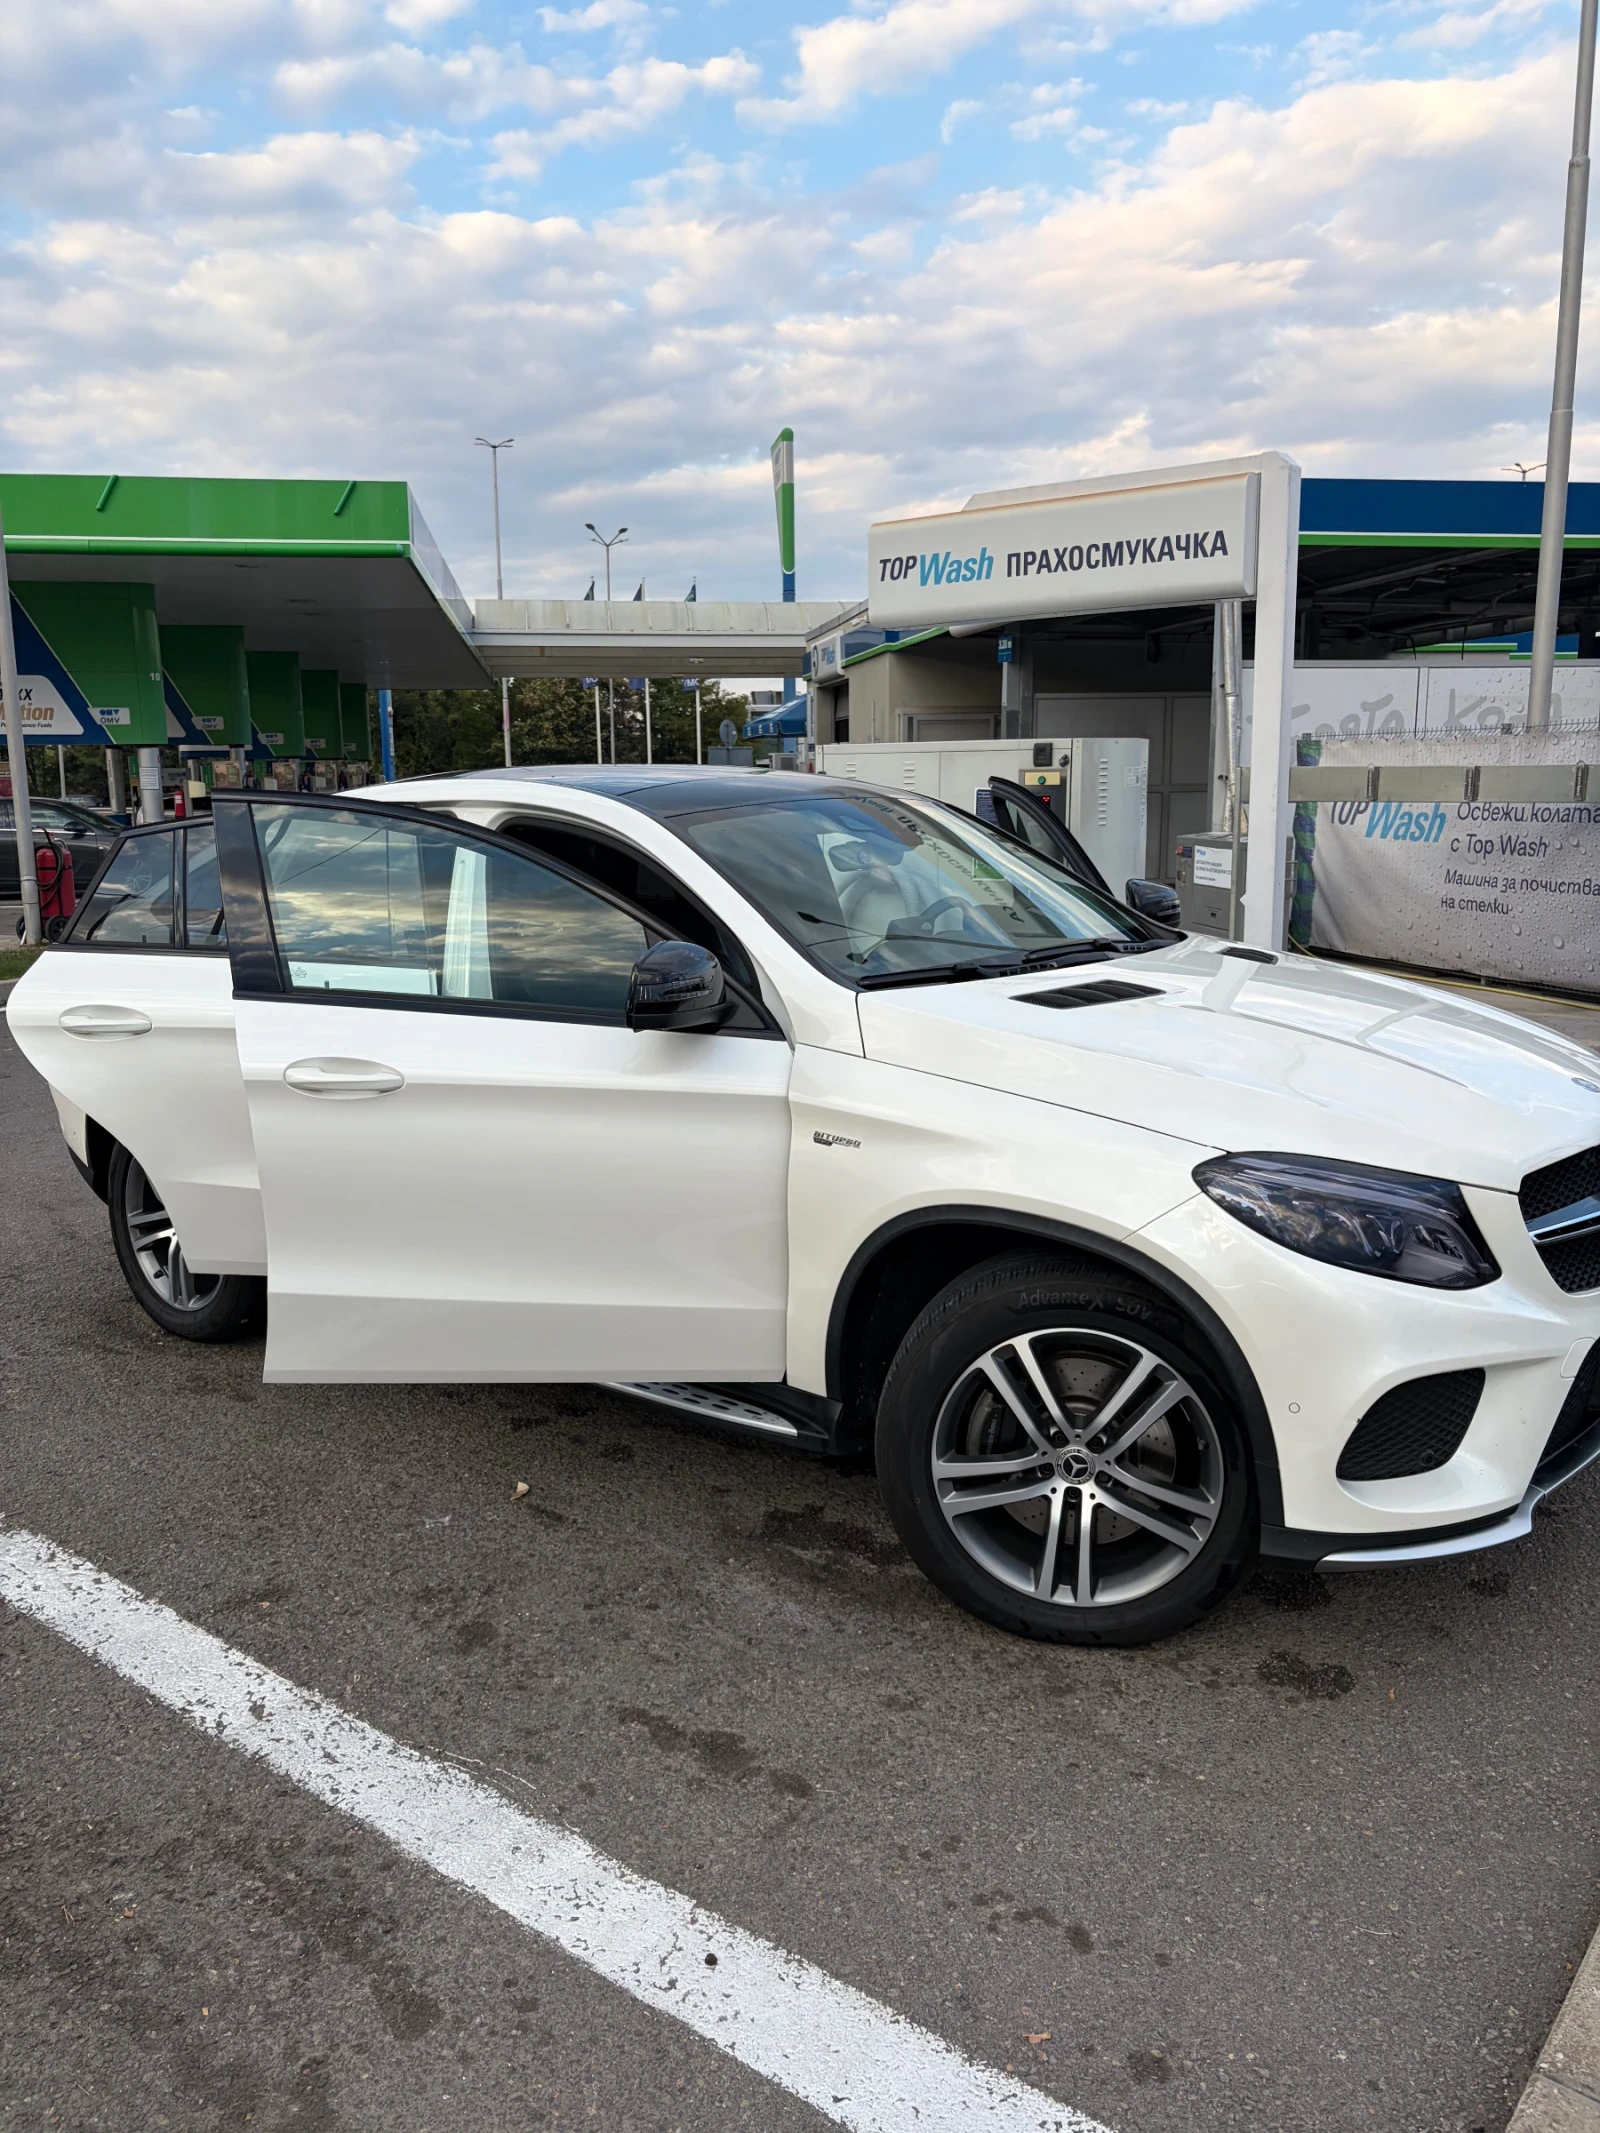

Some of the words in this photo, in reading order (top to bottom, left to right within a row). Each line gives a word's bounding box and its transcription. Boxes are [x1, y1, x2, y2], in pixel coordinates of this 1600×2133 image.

[1006, 530, 1229, 578] ПРАХОСМУКАЧКА
[149, 672, 160, 681] 10
[0, 702, 55, 721] tion
[1457, 802, 1525, 822] Освежи
[1466, 833, 1495, 860] Top
[1500, 835, 1549, 858] Wash
[1444, 868, 1499, 889] Машина
[1500, 877, 1516, 893] за
[1440, 896, 1455, 909] на
[1458, 898, 1510, 915] стелки
[813, 1130, 862, 1147] BITURBO
